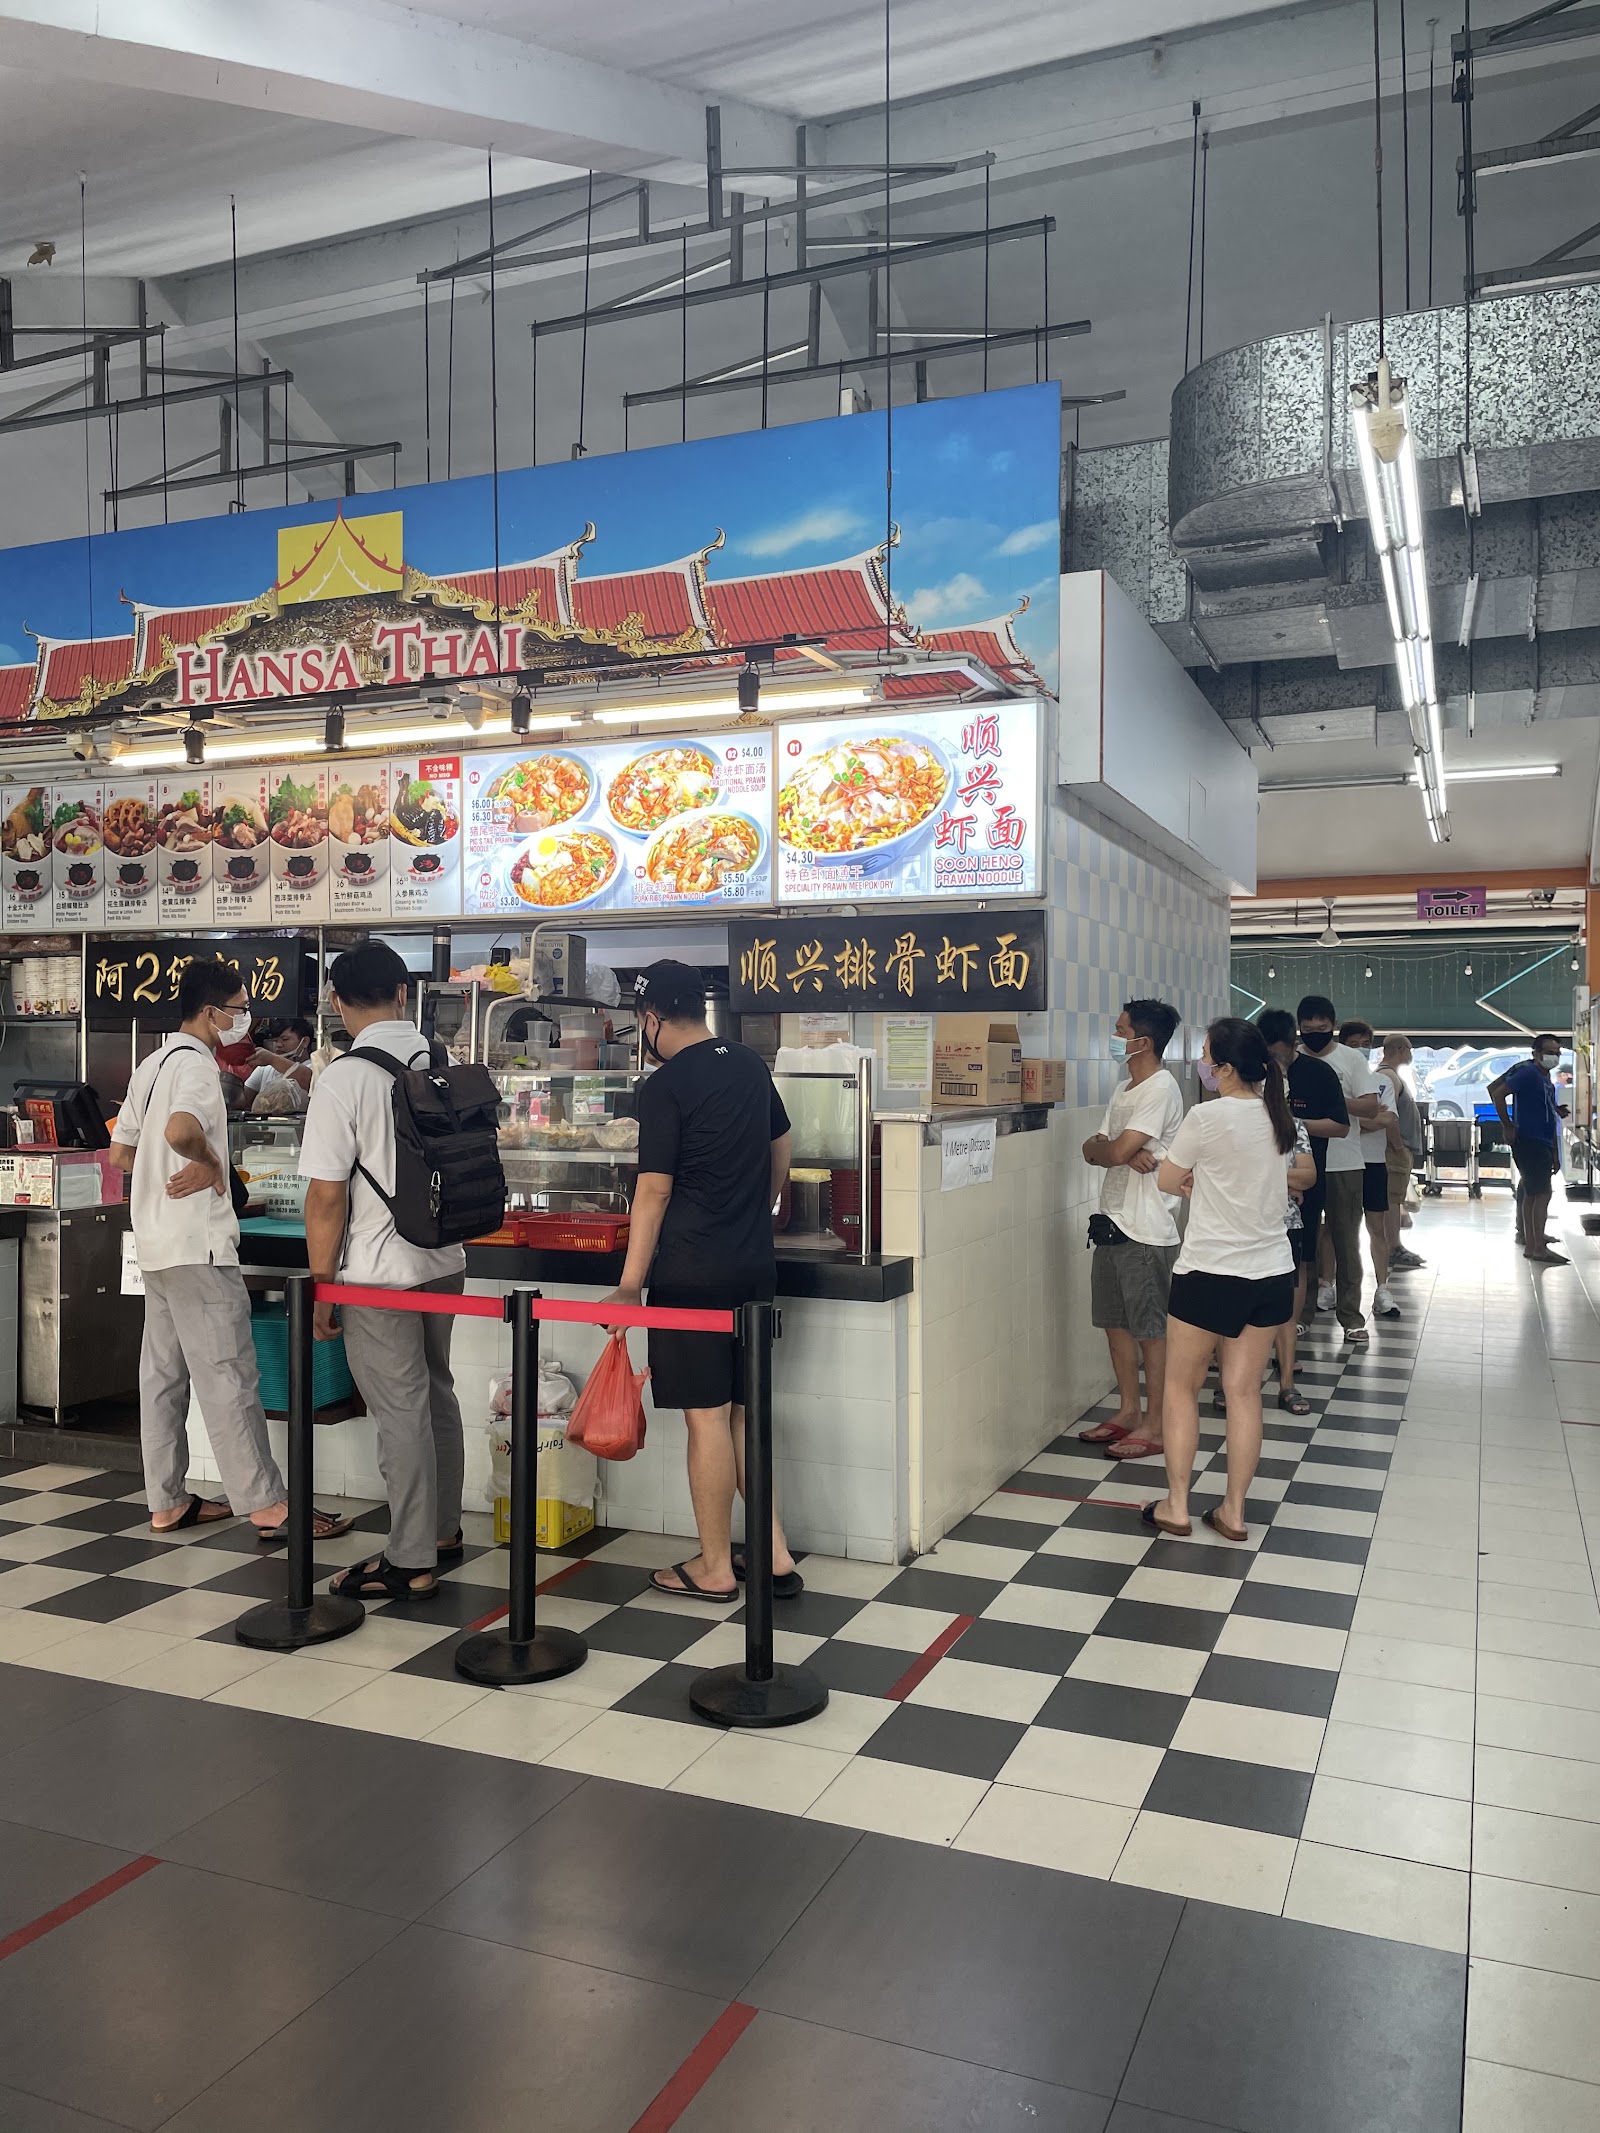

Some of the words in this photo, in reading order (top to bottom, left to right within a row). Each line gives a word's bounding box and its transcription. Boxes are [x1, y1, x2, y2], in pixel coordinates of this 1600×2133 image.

[177, 646, 360, 705] HANSA
[377, 623, 525, 685] THAI
[742, 747, 763, 757] $4.00
[746, 776, 766, 784] PRAWN
[728, 785, 749, 793] NOODLE
[750, 784, 766, 792] SOUP
[472, 800, 490, 809] $6.00
[472, 812, 490, 821] $6.30
[786, 851, 813, 864] $4.30
[936, 857, 977, 871] SOON
[981, 855, 1021, 869] HENG
[724, 873, 745, 883] $5.50
[936, 873, 975, 886] PRAWN
[978, 871, 1021, 884] NOODLE
[724, 886, 745, 897] $5.80
[785, 884, 821, 892] SPECIALITY
[822, 883, 847, 891] PRAWN
[849, 882, 863, 890] MEE
[864, 881, 878, 890] POK
[880, 880, 894, 889] DRY
[501, 897, 519, 906] $3.80
[1424, 905, 1478, 917] TOILET
[740, 931, 1030, 998] 顺兴排骨虾面
[950, 1141, 968, 1156] Metre
[970, 1138, 990, 1151] Distance
